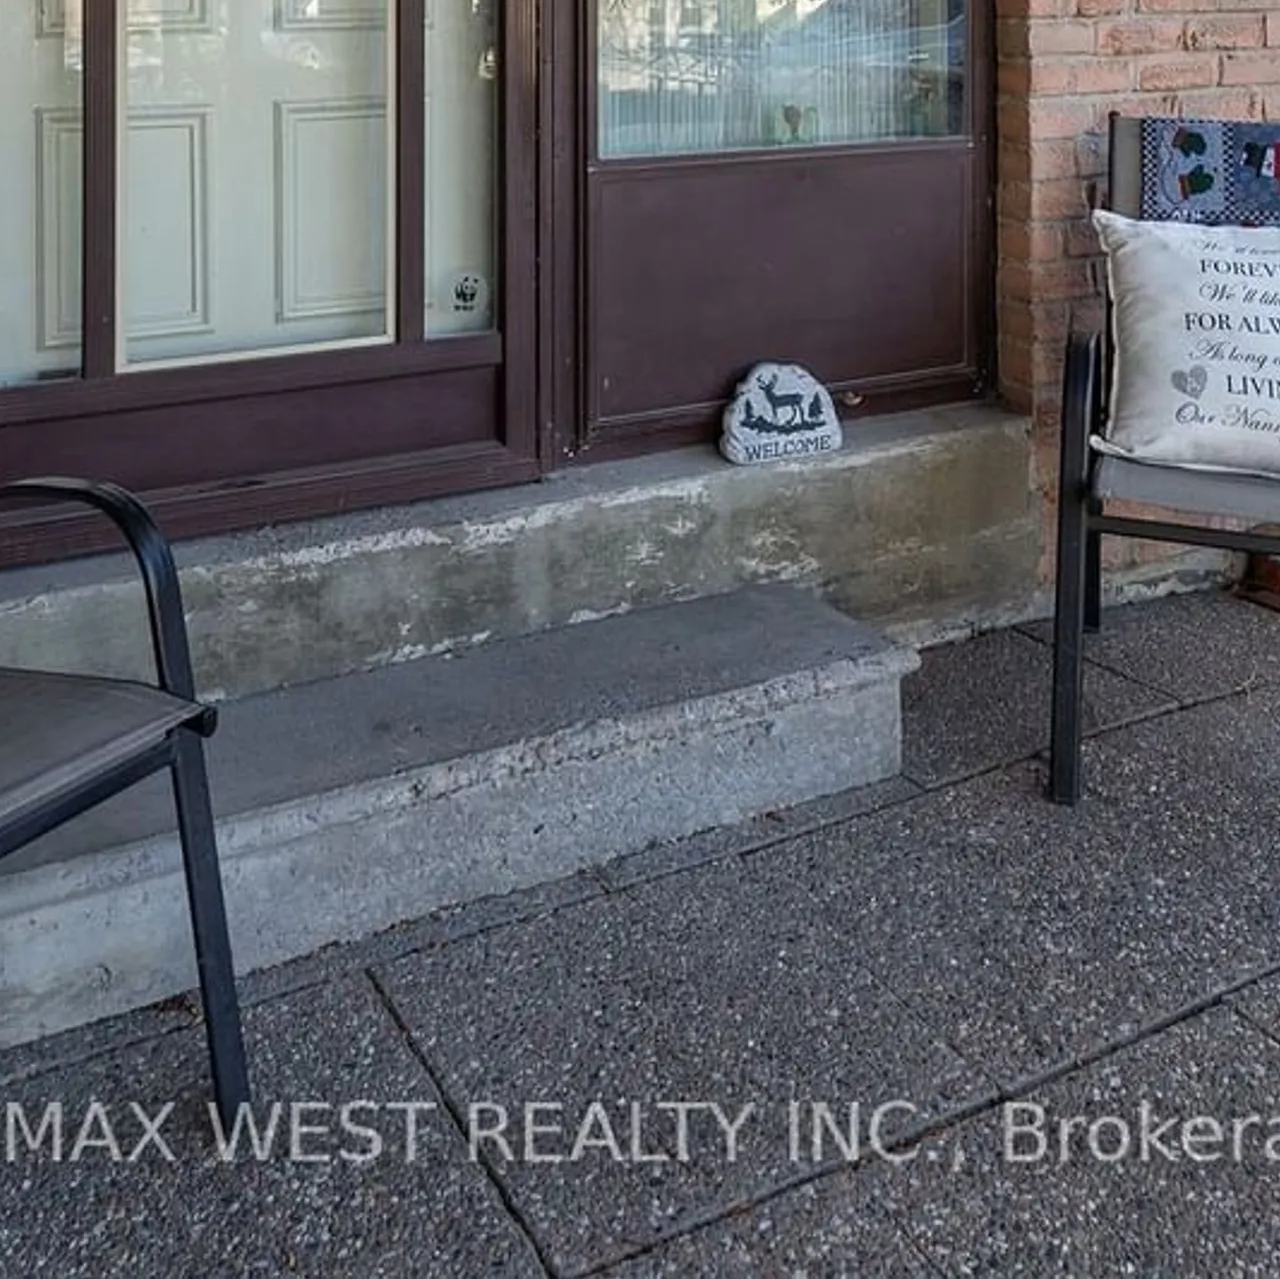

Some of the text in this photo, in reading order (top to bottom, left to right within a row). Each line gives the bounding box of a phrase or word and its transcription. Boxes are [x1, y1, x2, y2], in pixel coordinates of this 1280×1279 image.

[1184, 312, 1232, 331] FOR
[1189, 339, 1226, 361] As
[1228, 347, 1268, 371] long
[1175, 401, 1217, 425] Our
[744, 435, 832, 461] WELCOME
